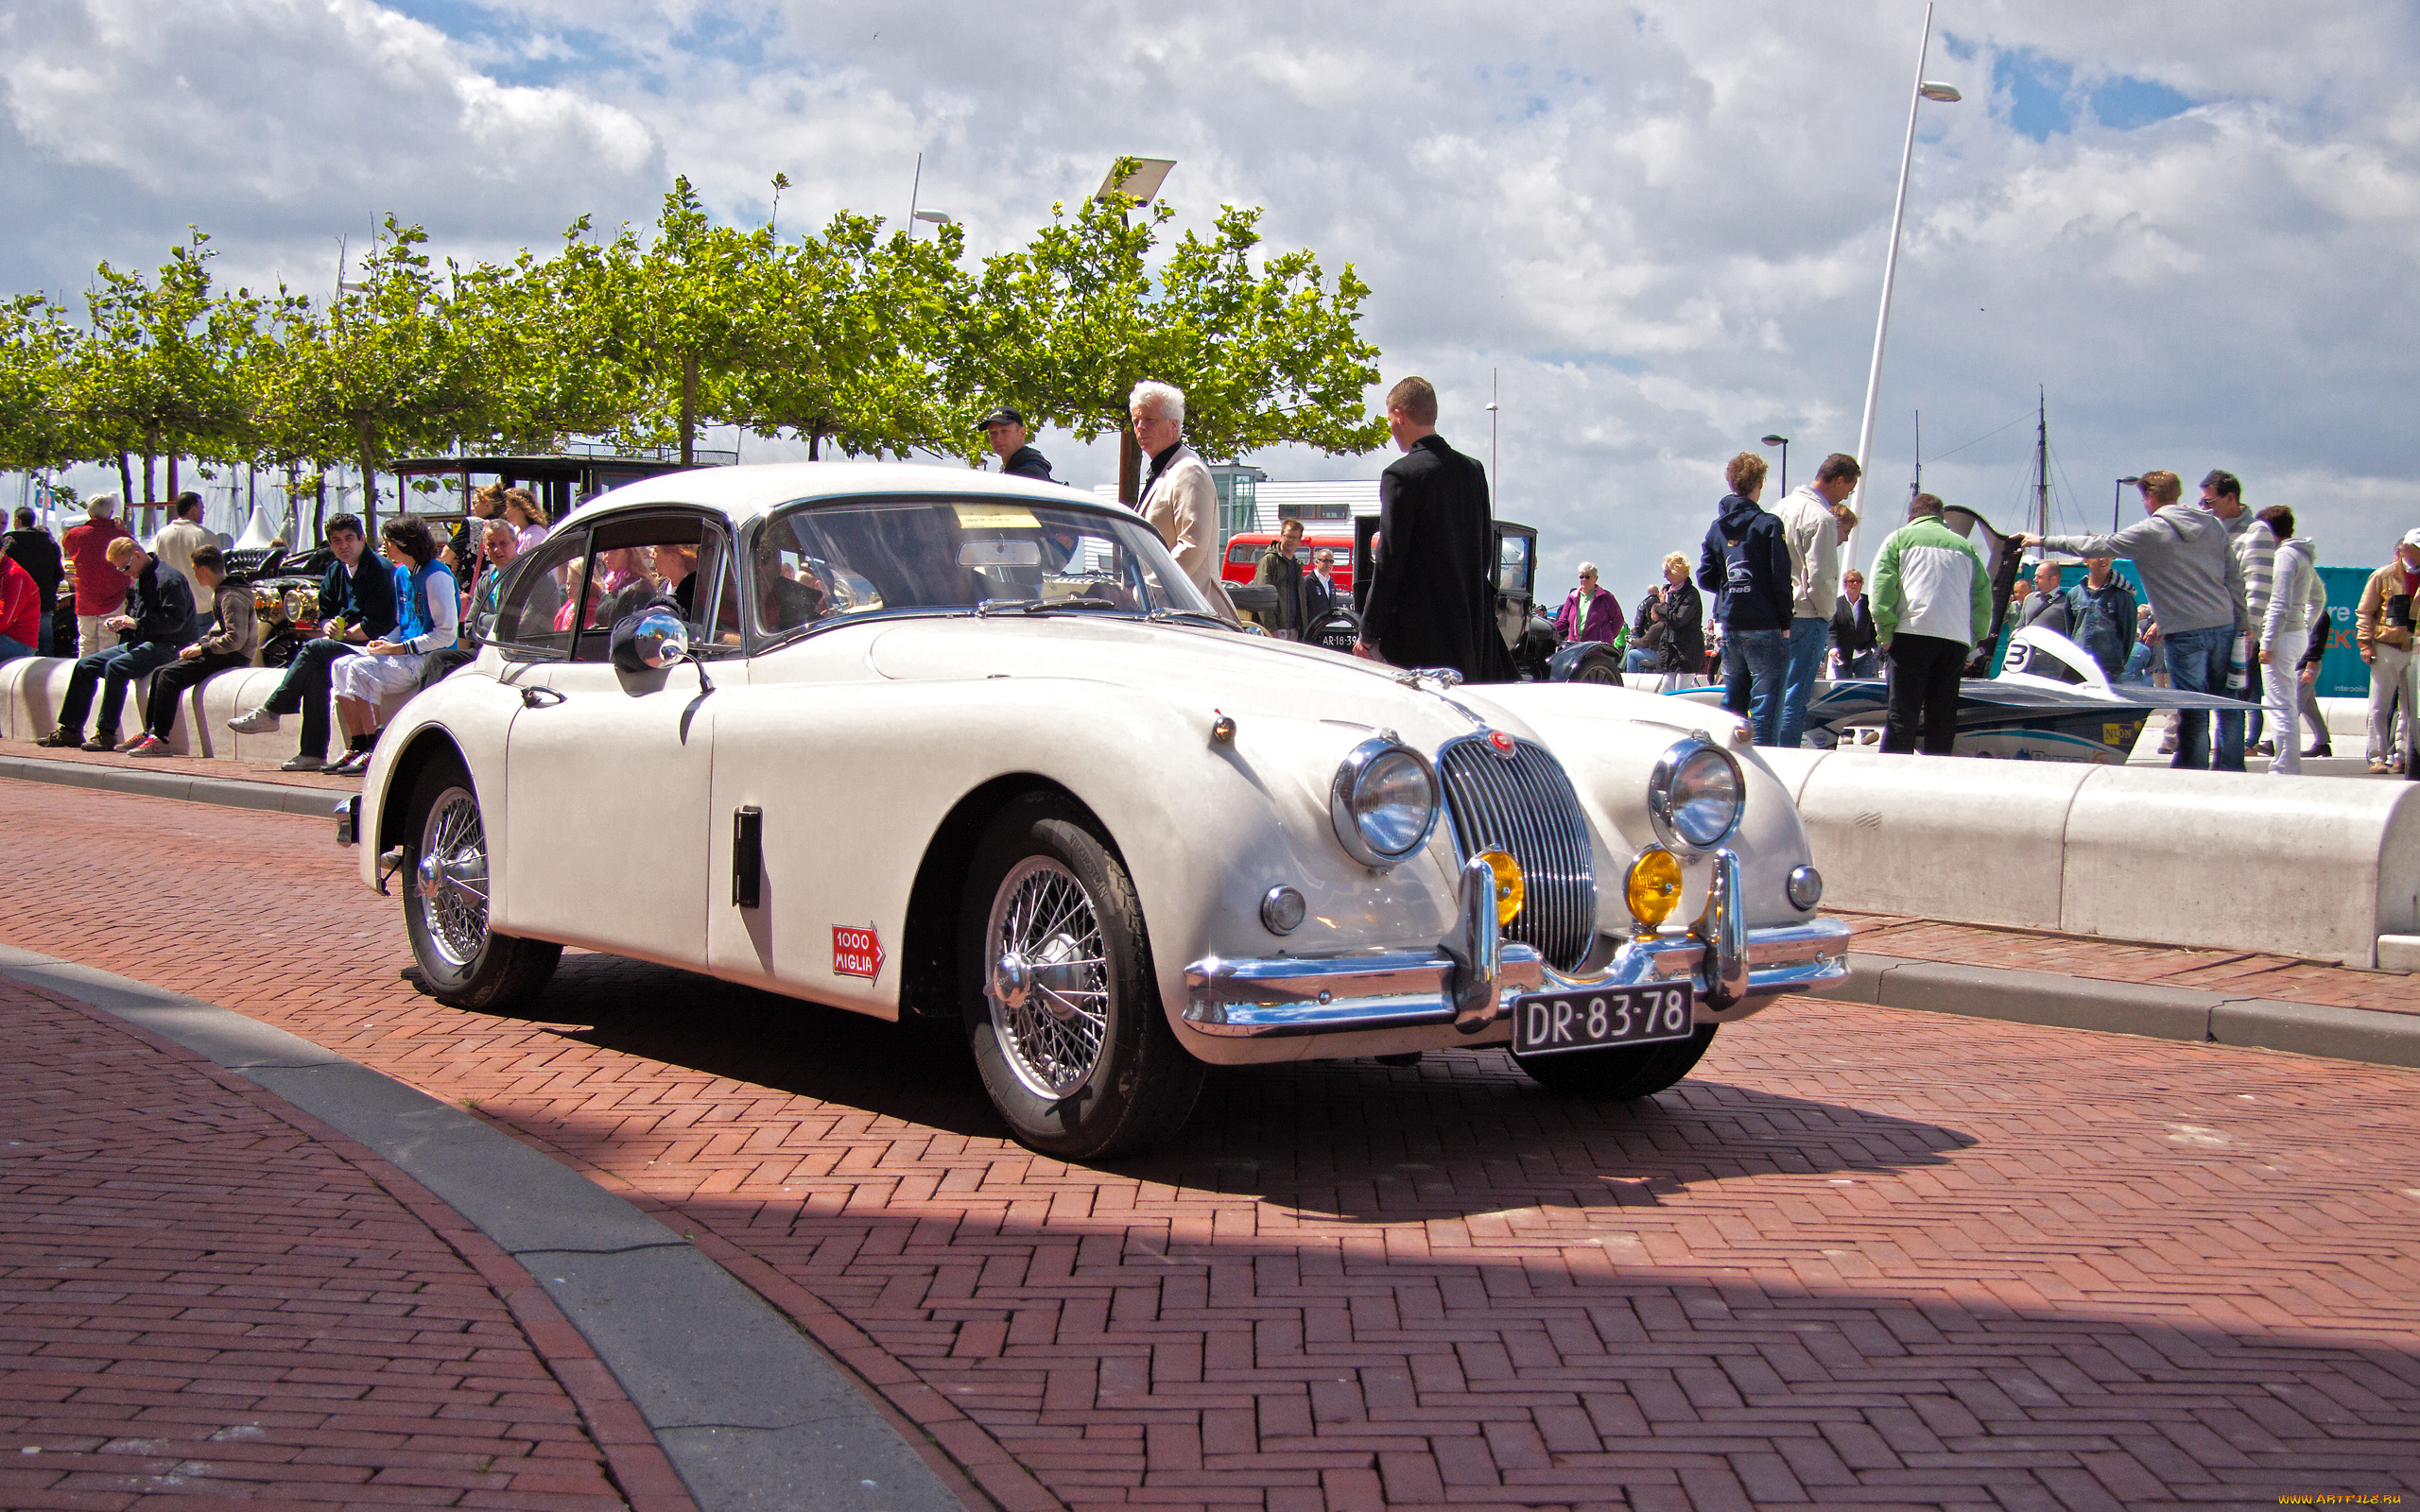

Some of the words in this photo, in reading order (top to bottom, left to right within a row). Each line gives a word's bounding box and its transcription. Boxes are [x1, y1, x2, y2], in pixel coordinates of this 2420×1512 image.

[2004, 644, 2029, 665] 3
[837, 931, 870, 950] 1000
[836, 953, 873, 972] MIGLIA
[1526, 989, 1684, 1045] DR-83-78
